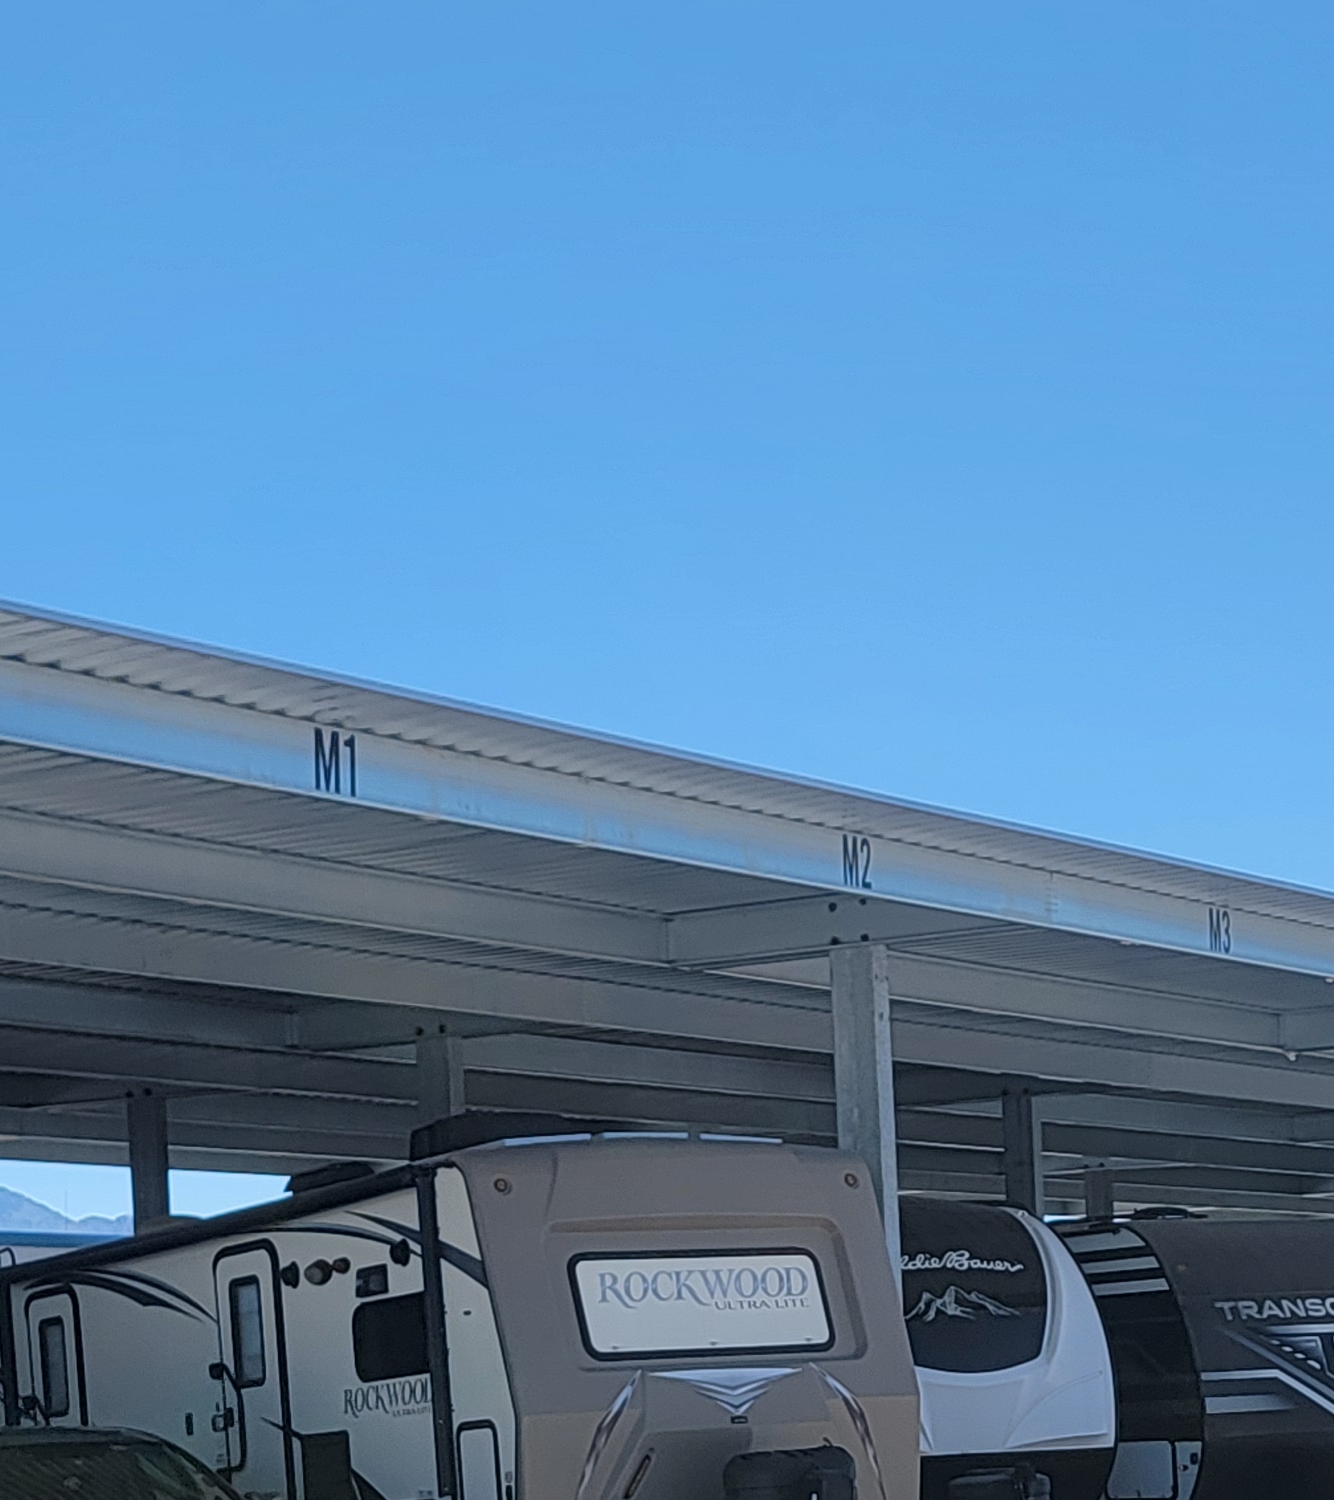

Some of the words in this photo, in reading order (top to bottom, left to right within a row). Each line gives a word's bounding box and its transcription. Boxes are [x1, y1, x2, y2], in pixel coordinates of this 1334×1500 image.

[313, 727, 357, 798] M1
[842, 834, 873, 890] M2
[1208, 907, 1232, 955] M3
[945, 1250, 1025, 1272] Bauer
[597, 1266, 809, 1309] ROCKWOOD
[714, 1299, 772, 1311] ULTRA
[775, 1297, 810, 1309] LITE
